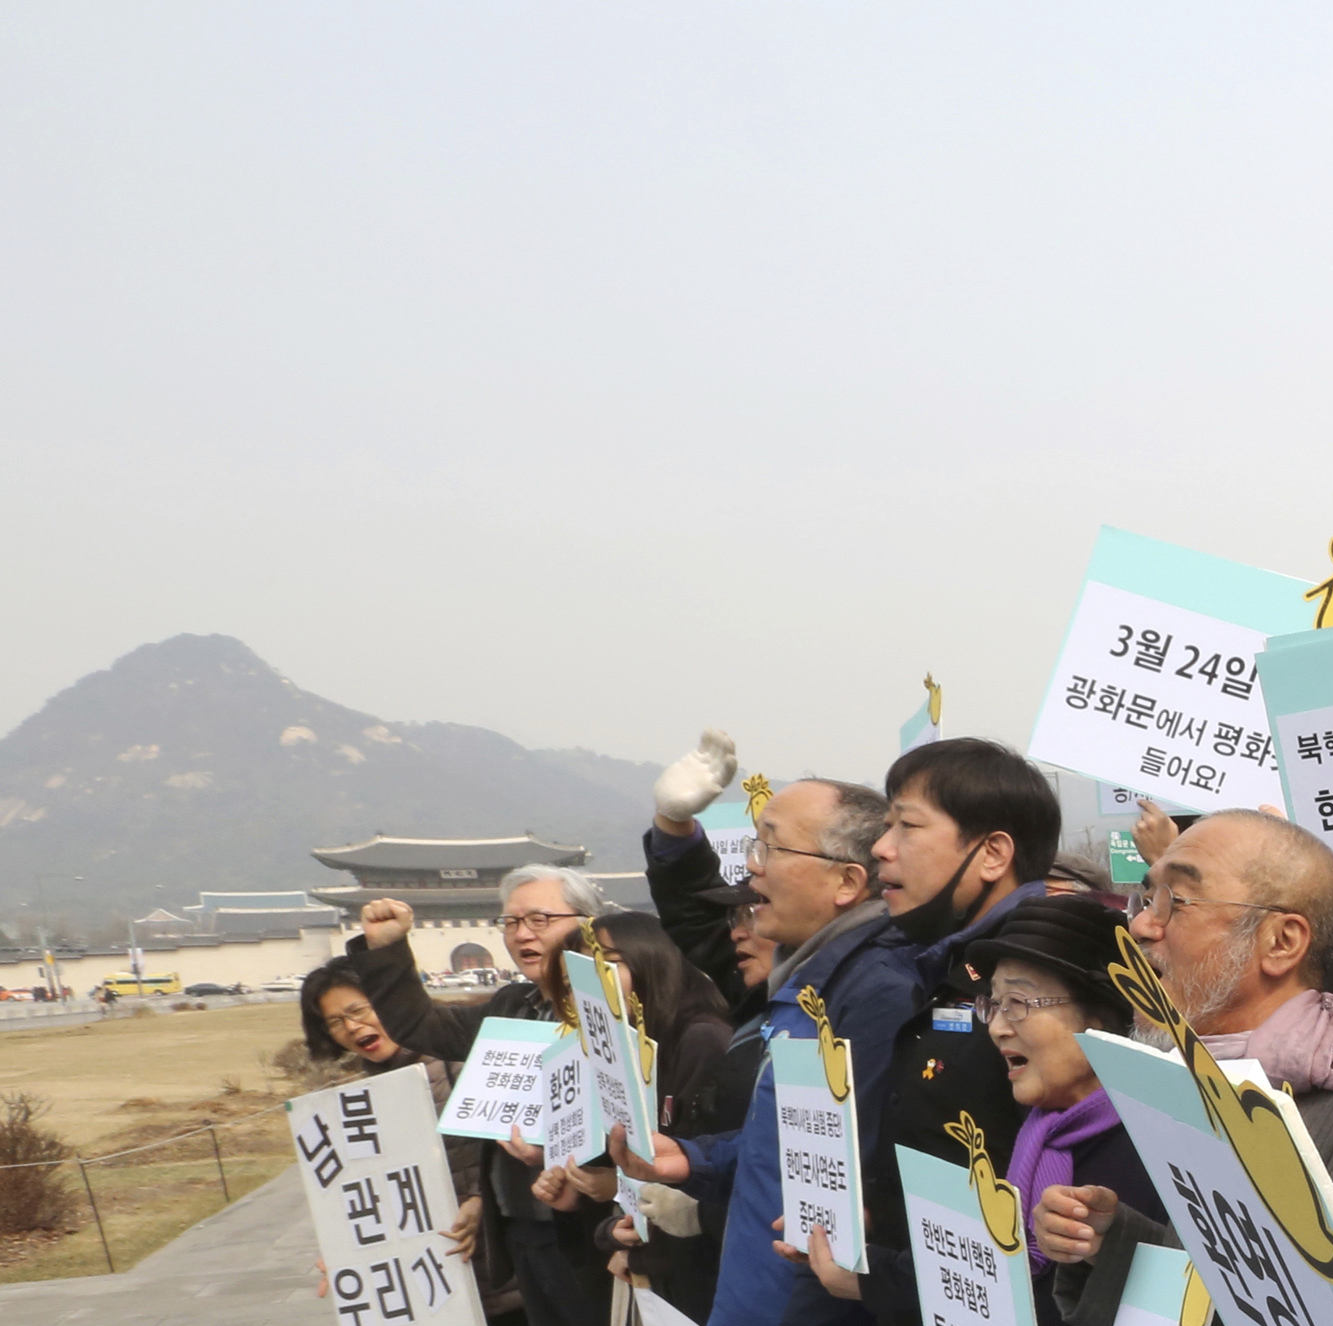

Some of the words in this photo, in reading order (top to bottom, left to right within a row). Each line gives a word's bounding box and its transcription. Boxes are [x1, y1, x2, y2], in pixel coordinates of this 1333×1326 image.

[1109, 624, 1173, 673] 3월
[1174, 645, 1259, 701] 24일
[1065, 675, 1208, 747] 광화문에서
[1139, 745, 1226, 795] 들어요!
[482, 1050, 520, 1067] 한반도
[485, 1071, 537, 1092] 평화협정
[297, 1088, 382, 1189] 남북
[785, 1147, 847, 1192] 한미군사연습도
[341, 1164, 434, 1247] 관계
[921, 1217, 959, 1261] 한반도
[958, 1235, 998, 1283] 비핵화
[938, 1265, 990, 1320] 평화협정
